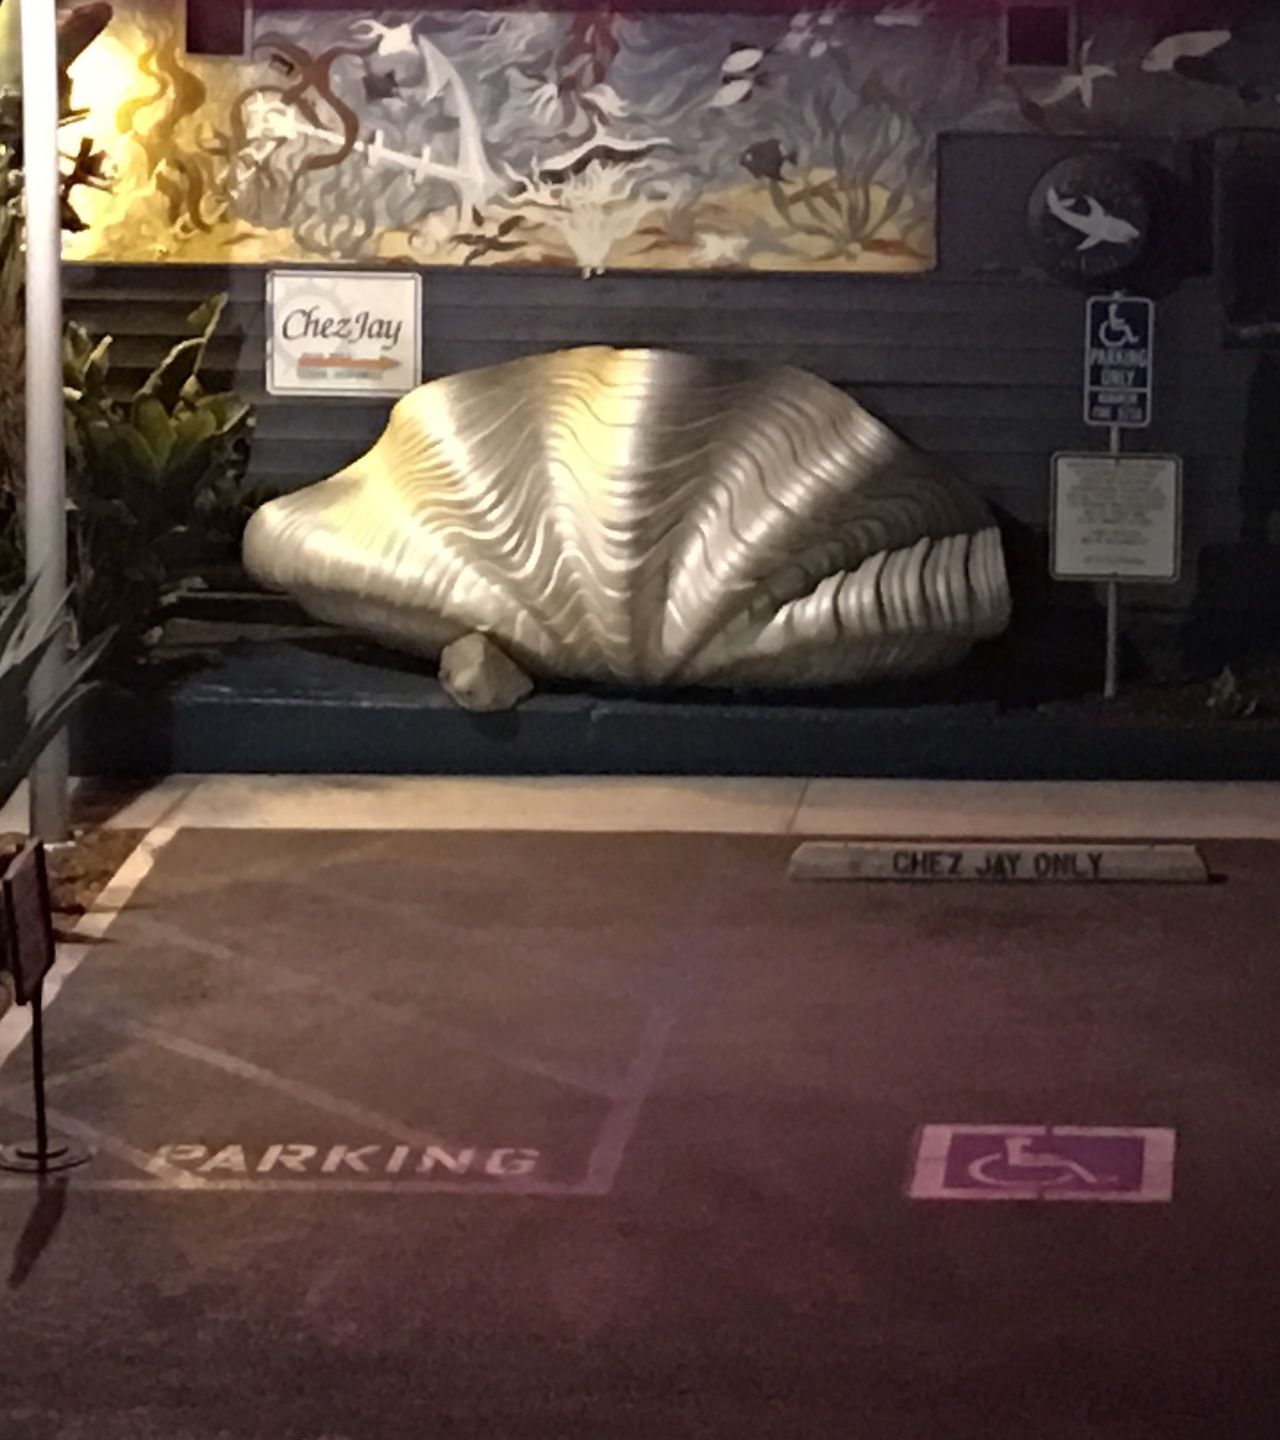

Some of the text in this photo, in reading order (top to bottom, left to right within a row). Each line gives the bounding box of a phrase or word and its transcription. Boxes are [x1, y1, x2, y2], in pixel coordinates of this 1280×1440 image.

[892, 849, 1106, 879] CHEZ JAY ONLY
[144, 1143, 542, 1175] PARKING
